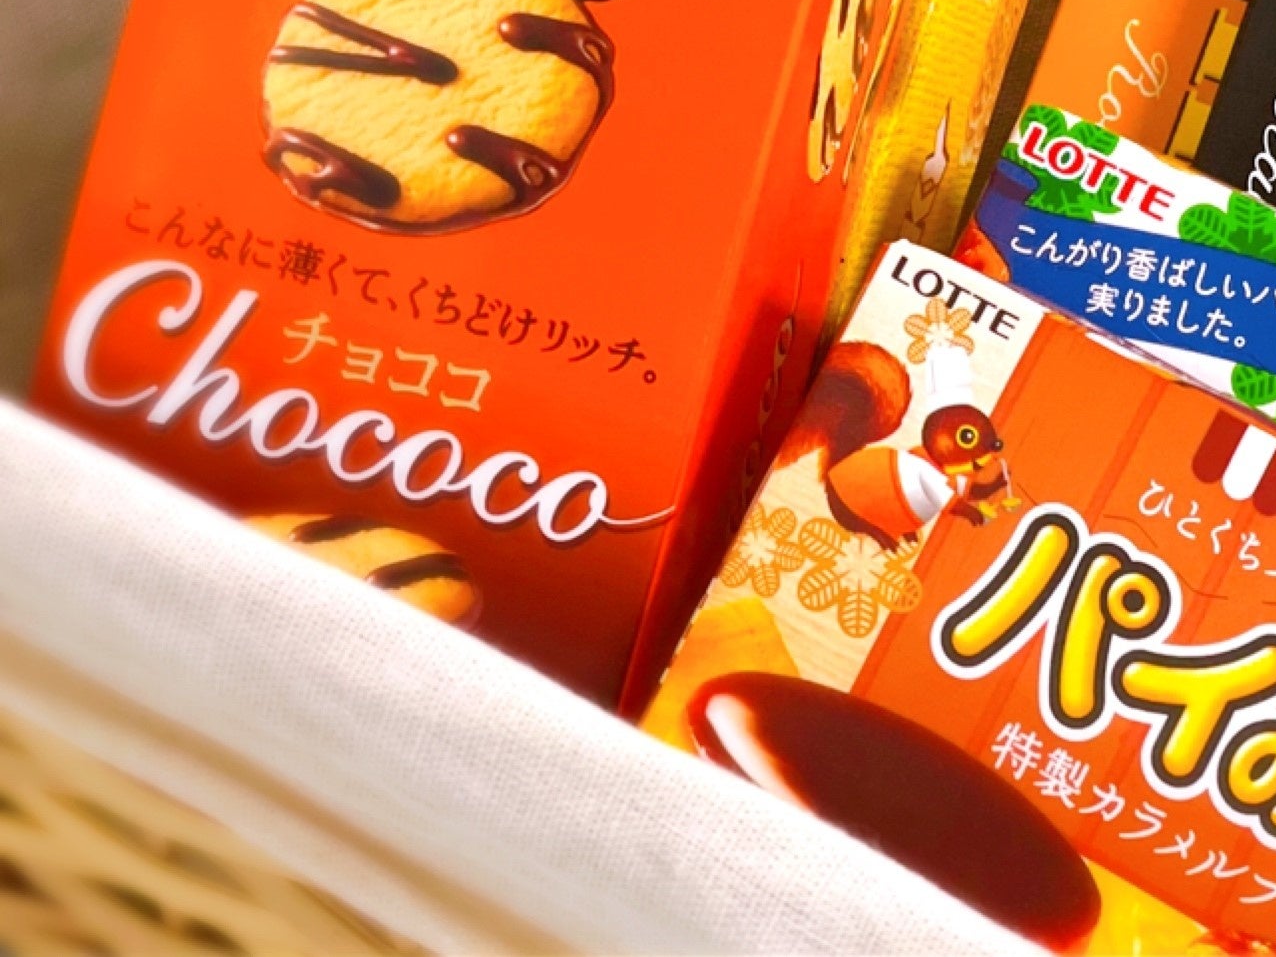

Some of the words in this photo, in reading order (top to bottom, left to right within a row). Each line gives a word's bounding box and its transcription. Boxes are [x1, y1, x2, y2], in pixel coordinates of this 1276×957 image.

[1018, 122, 1176, 222] LOTTE
[124, 197, 658, 385] こんなに薄くて、くちどけリッチ。
[891, 255, 1021, 340] LOTTE
[1085, 282, 1247, 349] 実りました。
[62, 258, 676, 545] Chococo
[283, 311, 492, 412] チョココ
